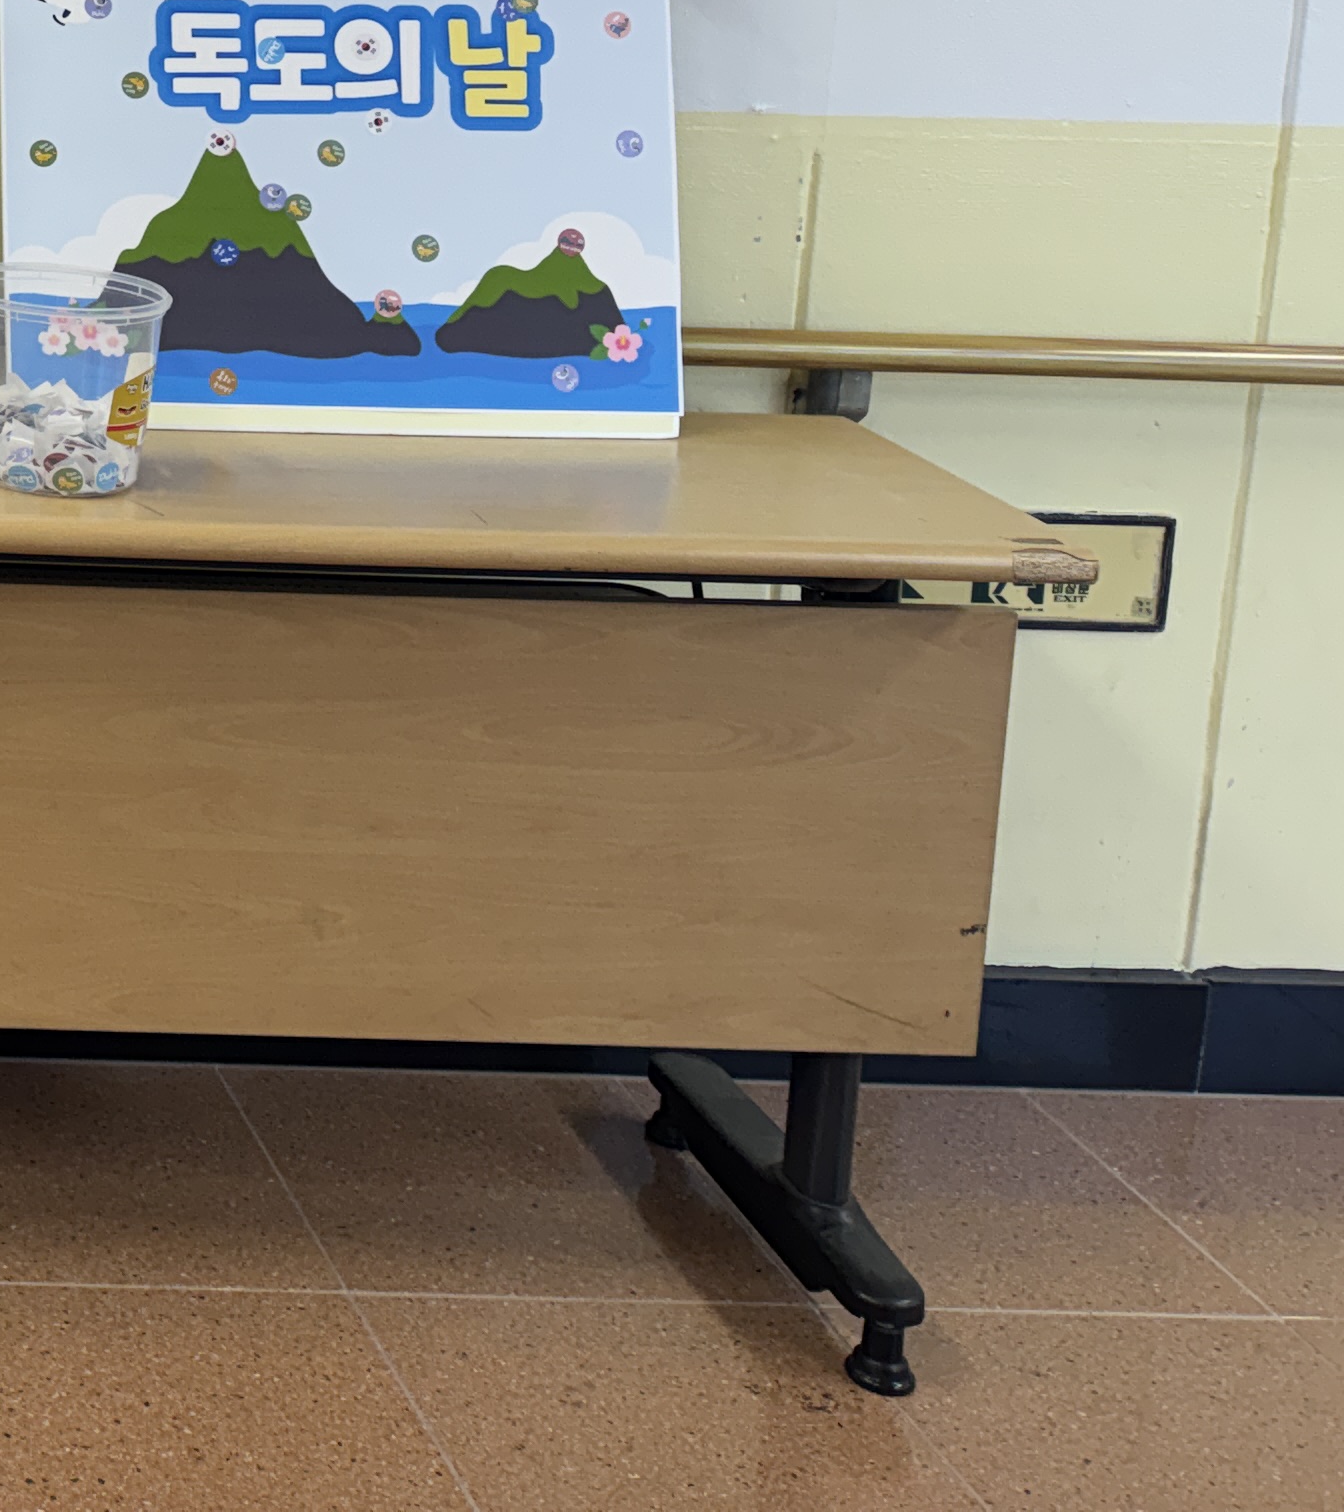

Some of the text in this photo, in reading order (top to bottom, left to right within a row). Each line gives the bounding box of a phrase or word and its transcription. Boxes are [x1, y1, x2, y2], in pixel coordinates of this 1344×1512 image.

[164, 12, 551, 118] 독도의 날
[1053, 595, 1087, 603] EXIT
